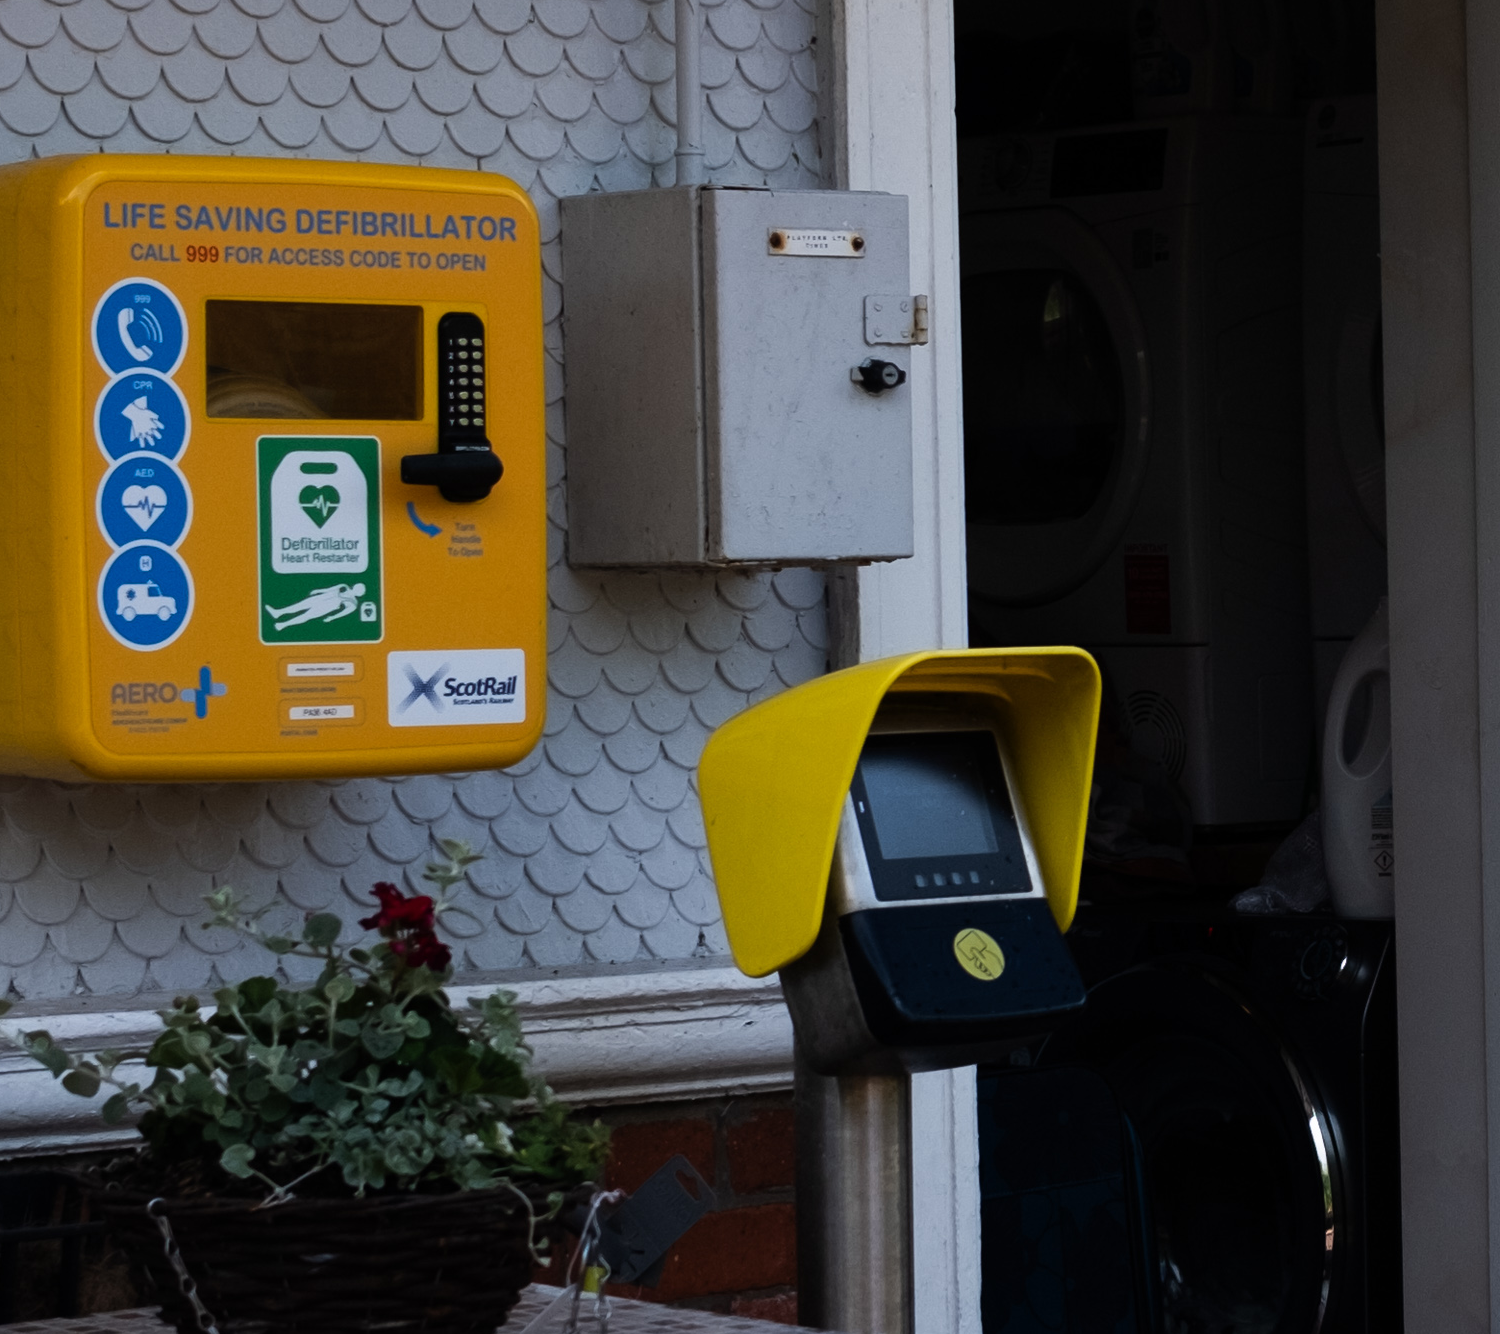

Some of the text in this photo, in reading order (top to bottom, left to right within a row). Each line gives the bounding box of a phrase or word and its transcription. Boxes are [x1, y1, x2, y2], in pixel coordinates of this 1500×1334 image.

[103, 202, 517, 242] LIFE SAVING DEFIBRILLATOR
[131, 243, 486, 271] CALL 999 FOR ACCESS CODE TO OPEN
[134, 295, 151, 303] 999
[133, 381, 153, 390] CPR
[135, 469, 154, 477] AED
[281, 537, 359, 551] Defibrillator
[281, 553, 360, 564] Heart Restarter
[112, 682, 178, 704] AERO
[444, 675, 517, 697] ScotRail
